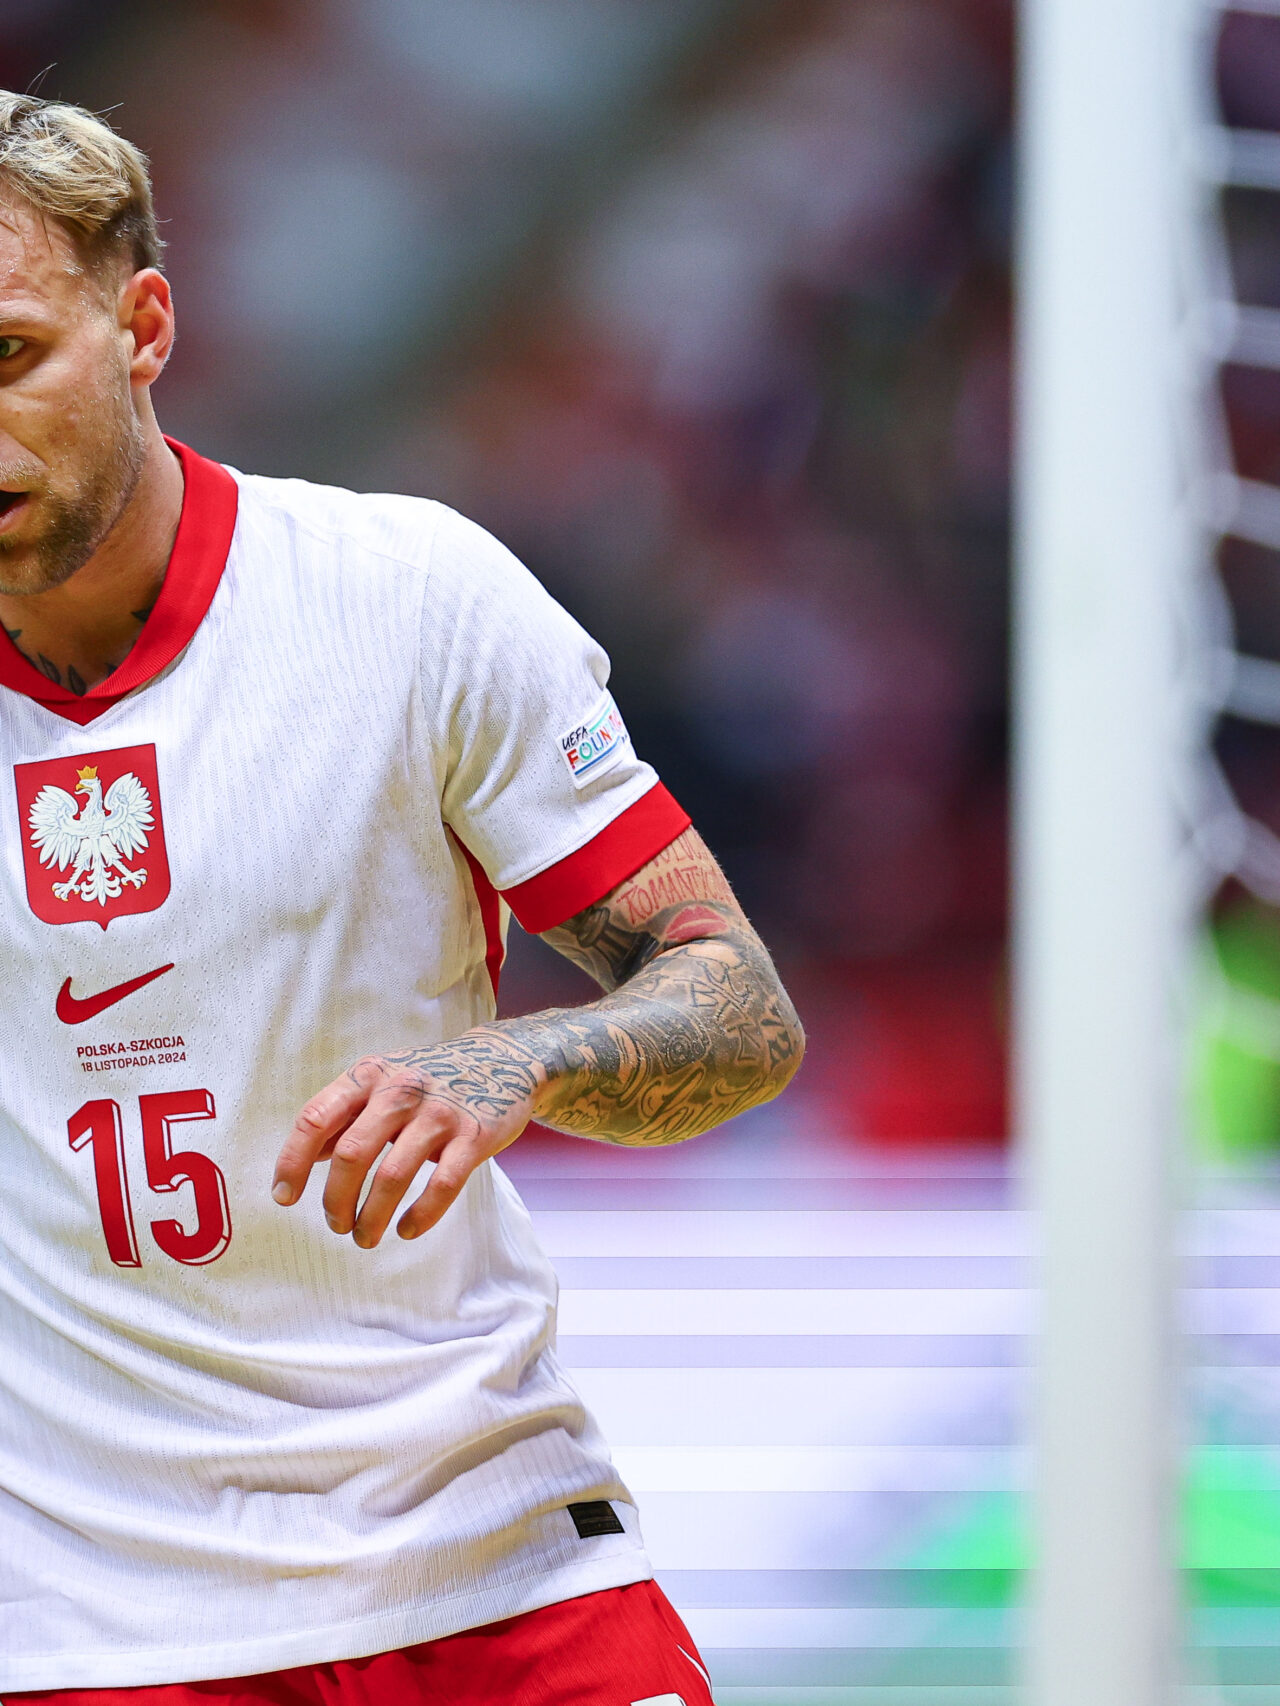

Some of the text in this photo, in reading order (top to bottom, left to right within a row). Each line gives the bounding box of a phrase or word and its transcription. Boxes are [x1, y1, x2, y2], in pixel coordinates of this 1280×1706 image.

[562, 726, 588, 750] UEFA
[77, 1036, 185, 1057] POLSKA-SZKOCJA
[81, 1052, 186, 1072] 18 LISTOPADA 2024
[67, 1088, 232, 1268] 15
